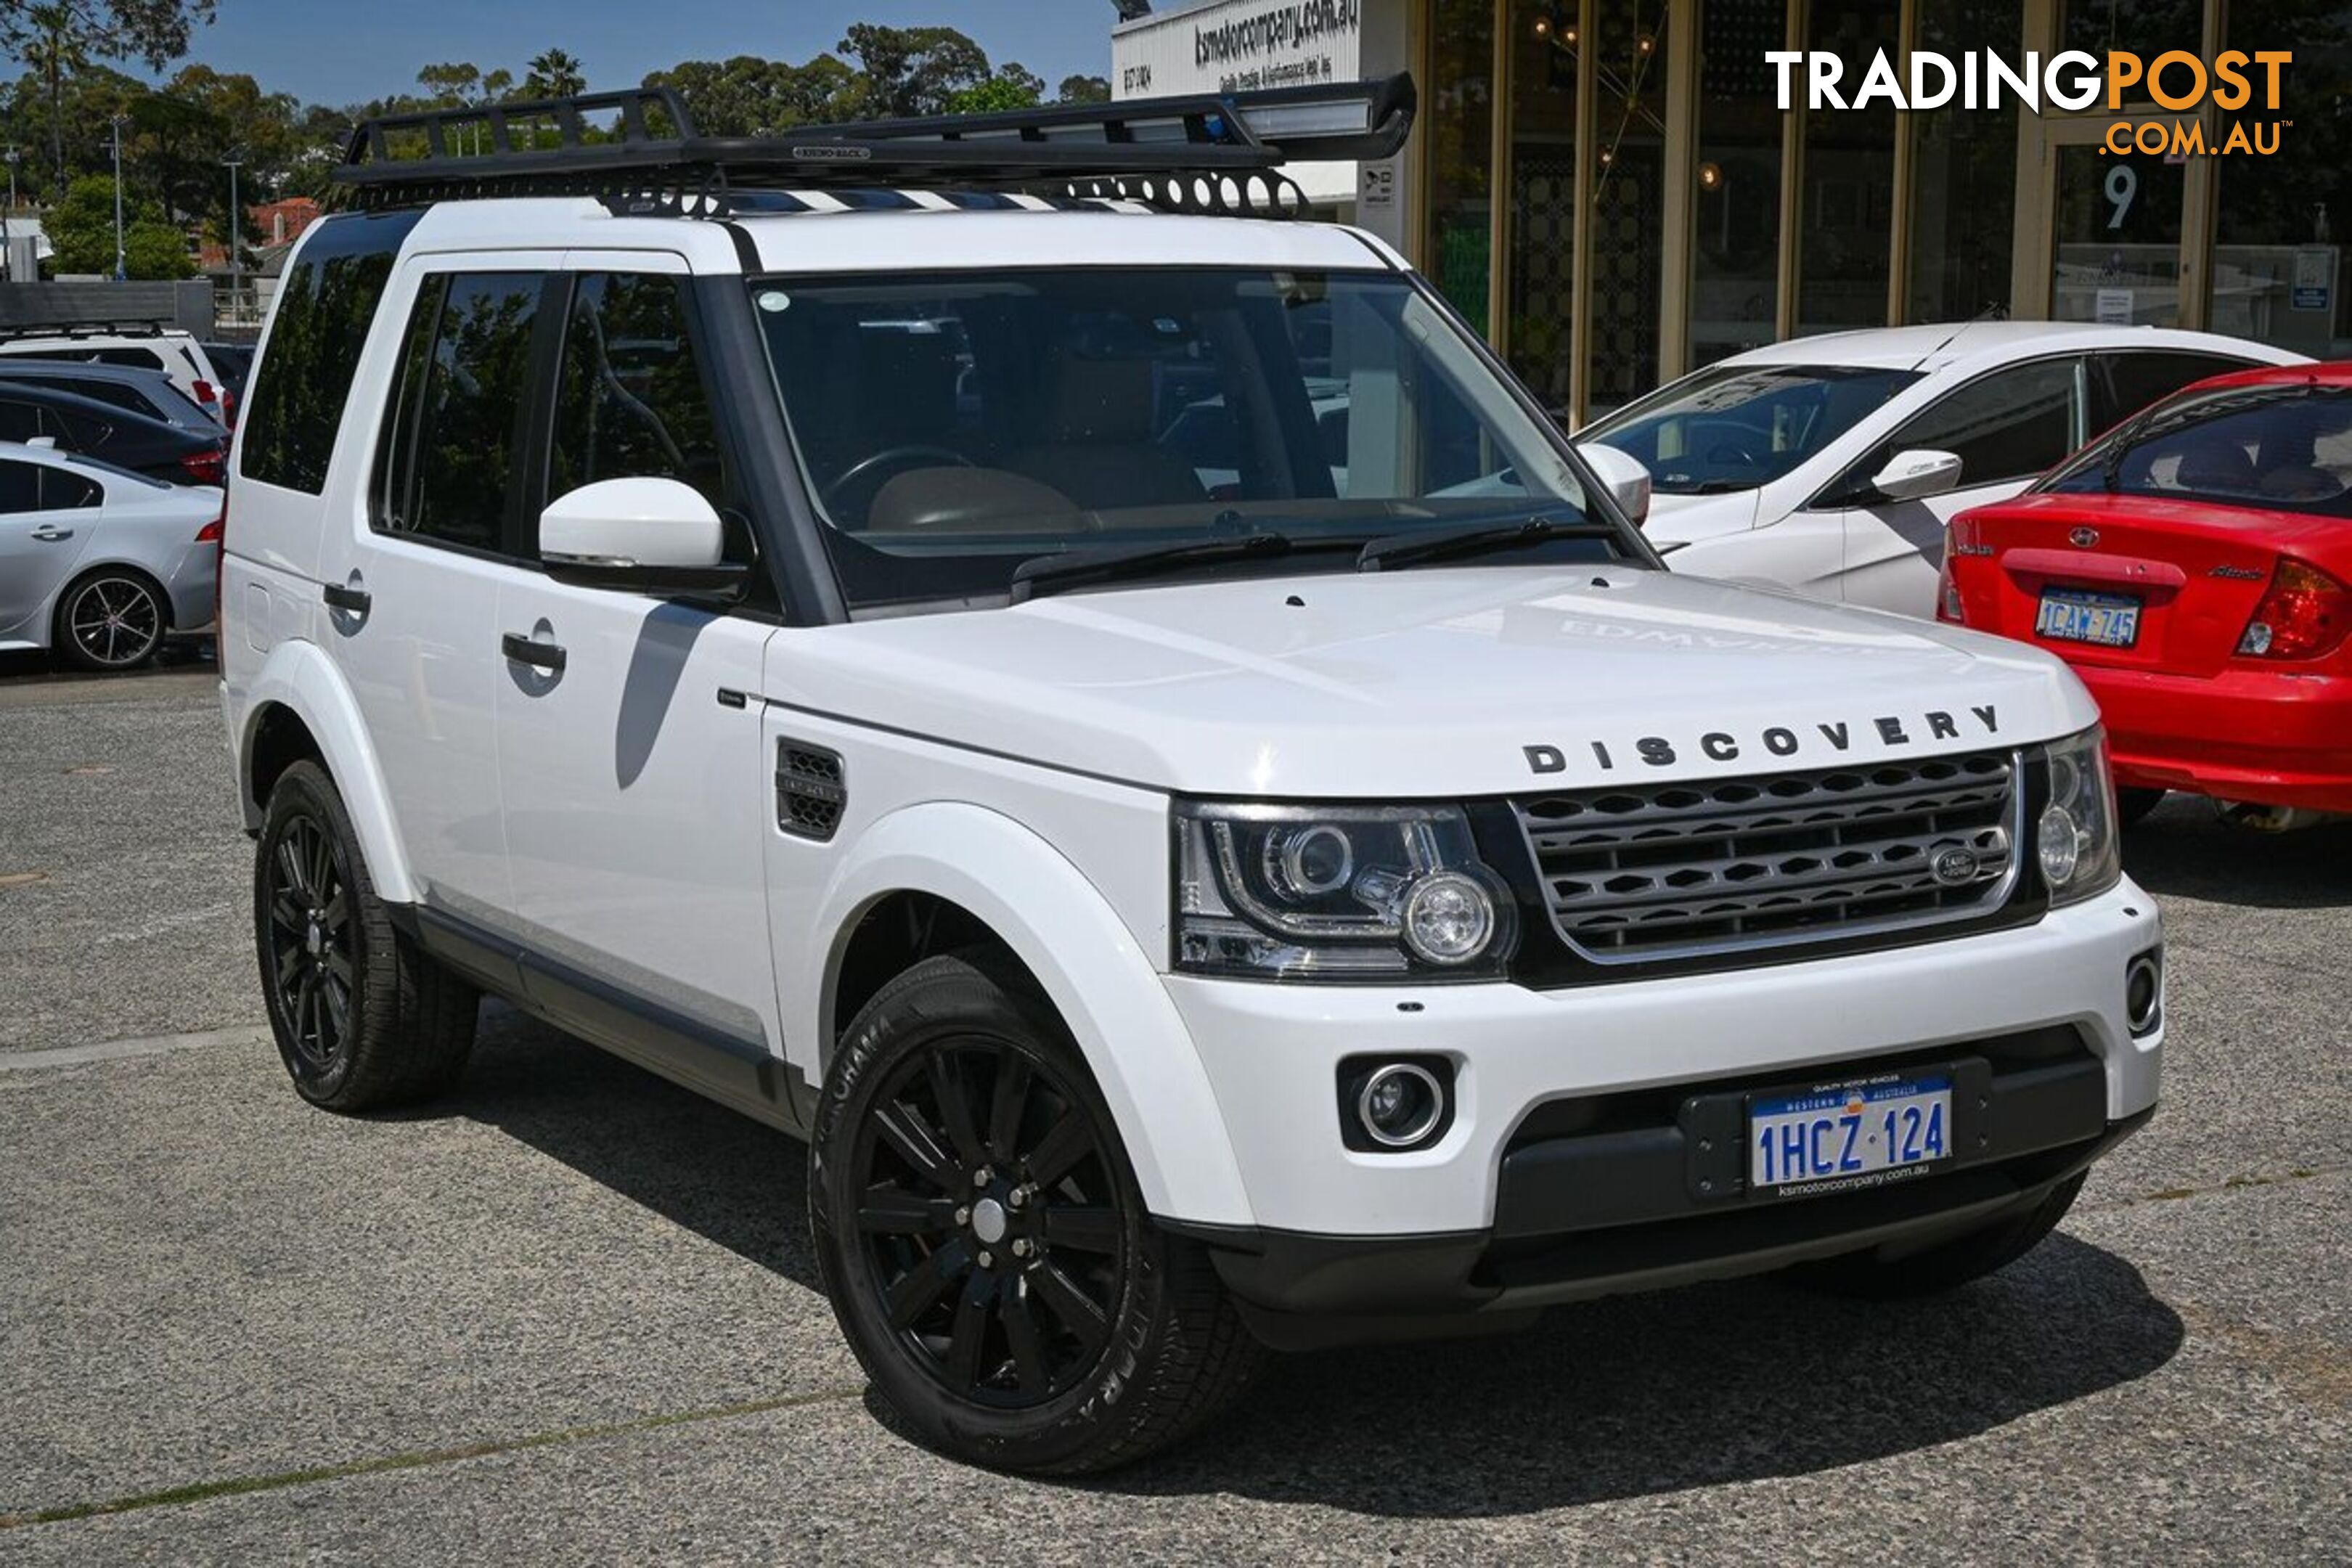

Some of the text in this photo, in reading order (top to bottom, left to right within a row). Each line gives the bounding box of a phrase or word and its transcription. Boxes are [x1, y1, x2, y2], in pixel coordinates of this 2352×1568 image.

[2105, 164, 2136, 229] 9
[1522, 705, 1999, 774] DISCOVERY
[1760, 1102, 1944, 1183] 1HCZ 124
[1779, 1164, 1930, 1198] ksmotorcompany.com.au
